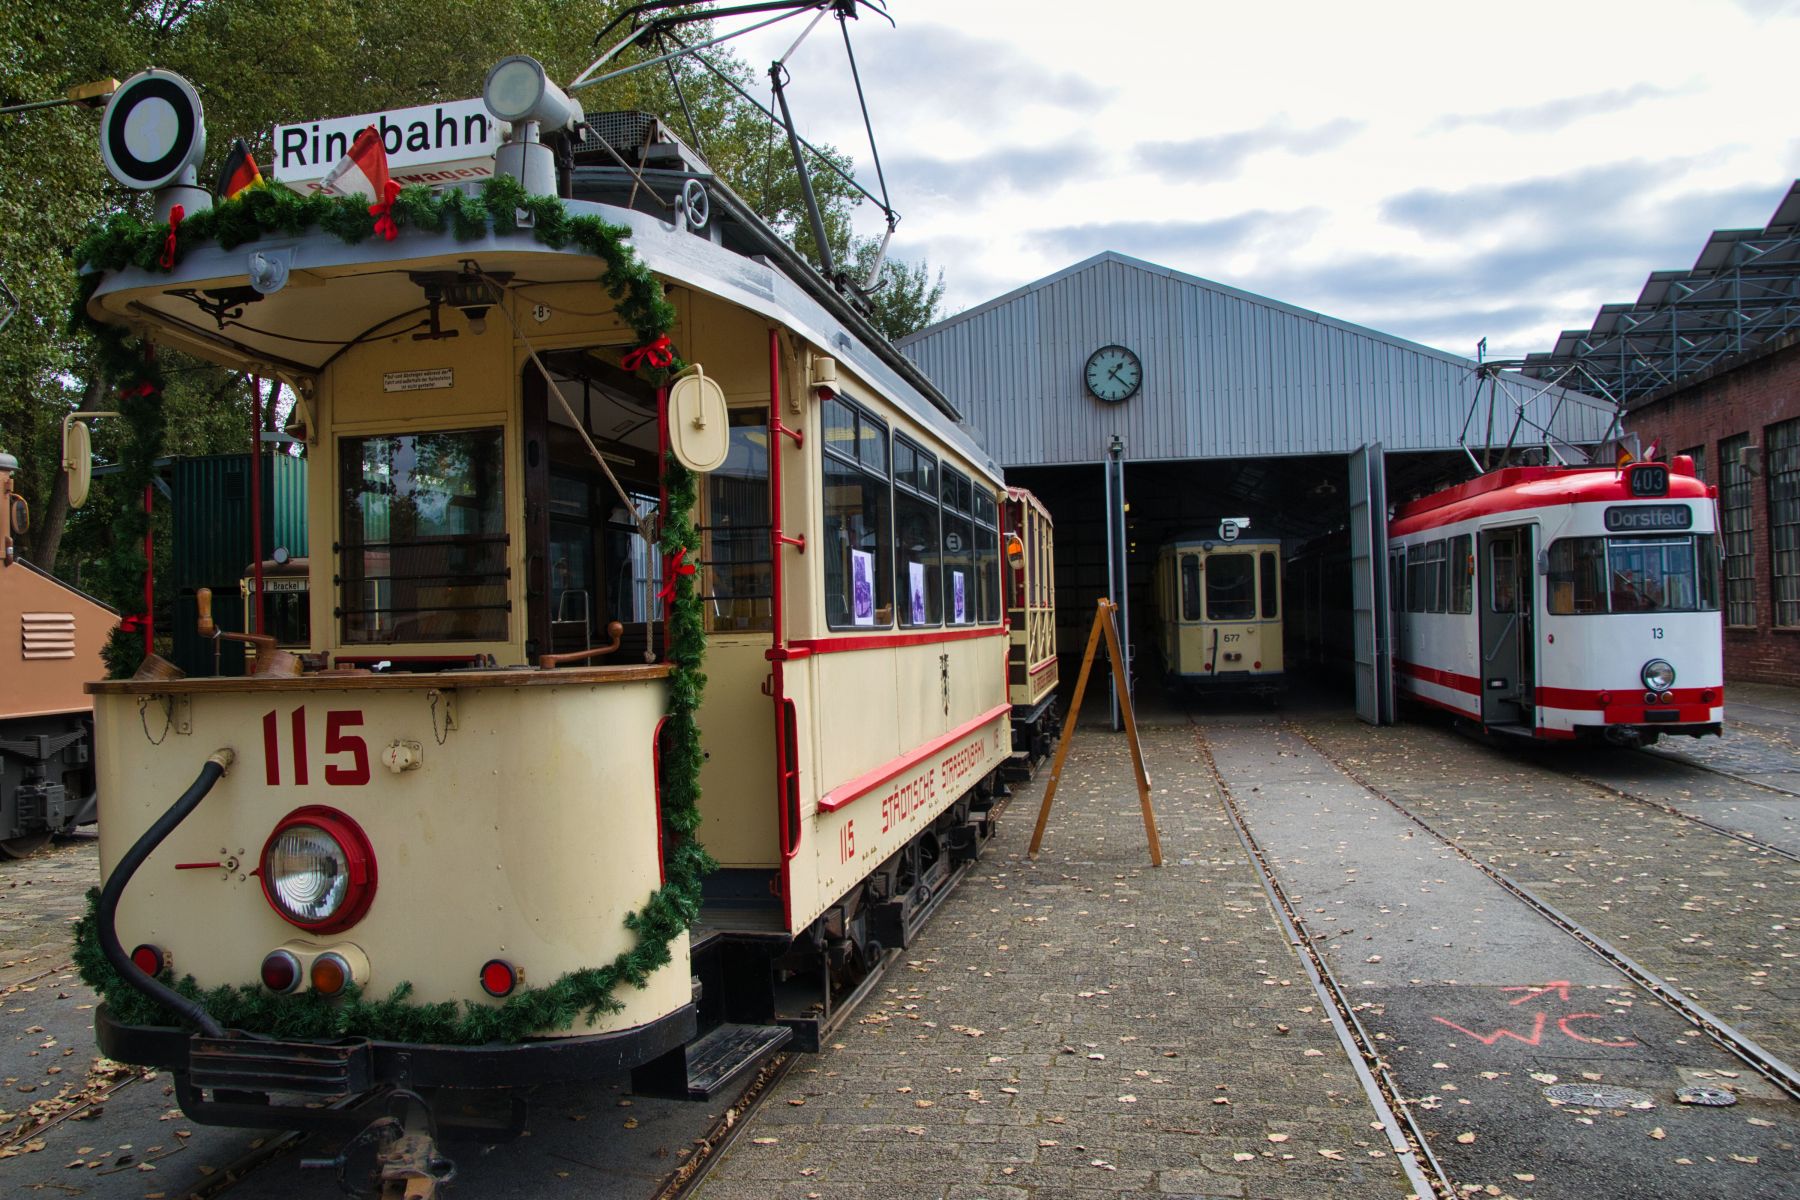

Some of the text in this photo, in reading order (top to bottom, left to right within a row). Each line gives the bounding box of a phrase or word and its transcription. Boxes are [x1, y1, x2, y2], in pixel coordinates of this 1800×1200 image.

[1632, 469, 1664, 491] 403
[1610, 508, 1688, 527] Dorstfeld
[1223, 523, 1236, 540] E
[1651, 627, 1664, 640] 13
[262, 704, 371, 786] 115
[840, 818, 855, 865] 115
[882, 768, 935, 834] STÄDTISCHE
[1432, 1011, 1639, 1046] WC
